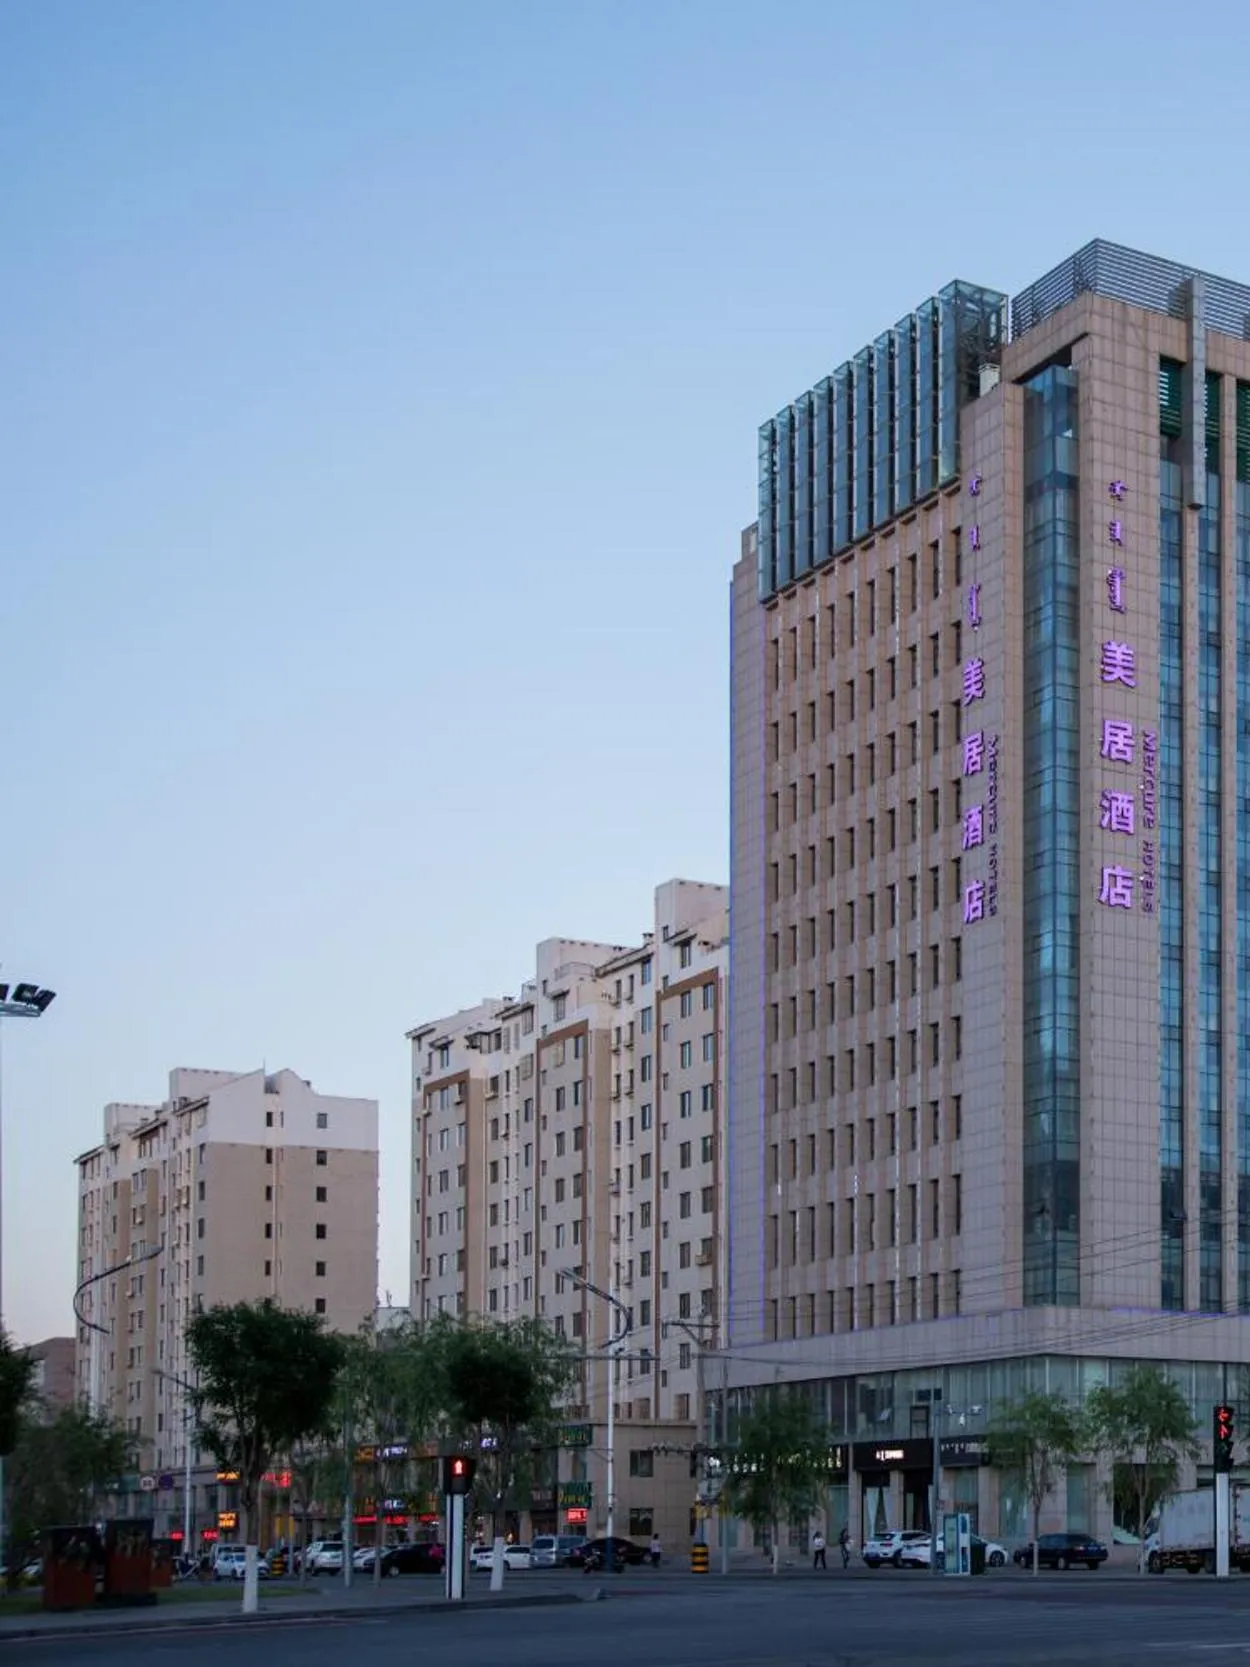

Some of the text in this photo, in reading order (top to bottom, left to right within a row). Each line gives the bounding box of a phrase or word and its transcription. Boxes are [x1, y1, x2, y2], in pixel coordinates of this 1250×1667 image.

[962, 657, 986, 924] 美居酒店
[1099, 639, 1136, 909] 美居酒店
[1142, 729, 1158, 829] Mercure
